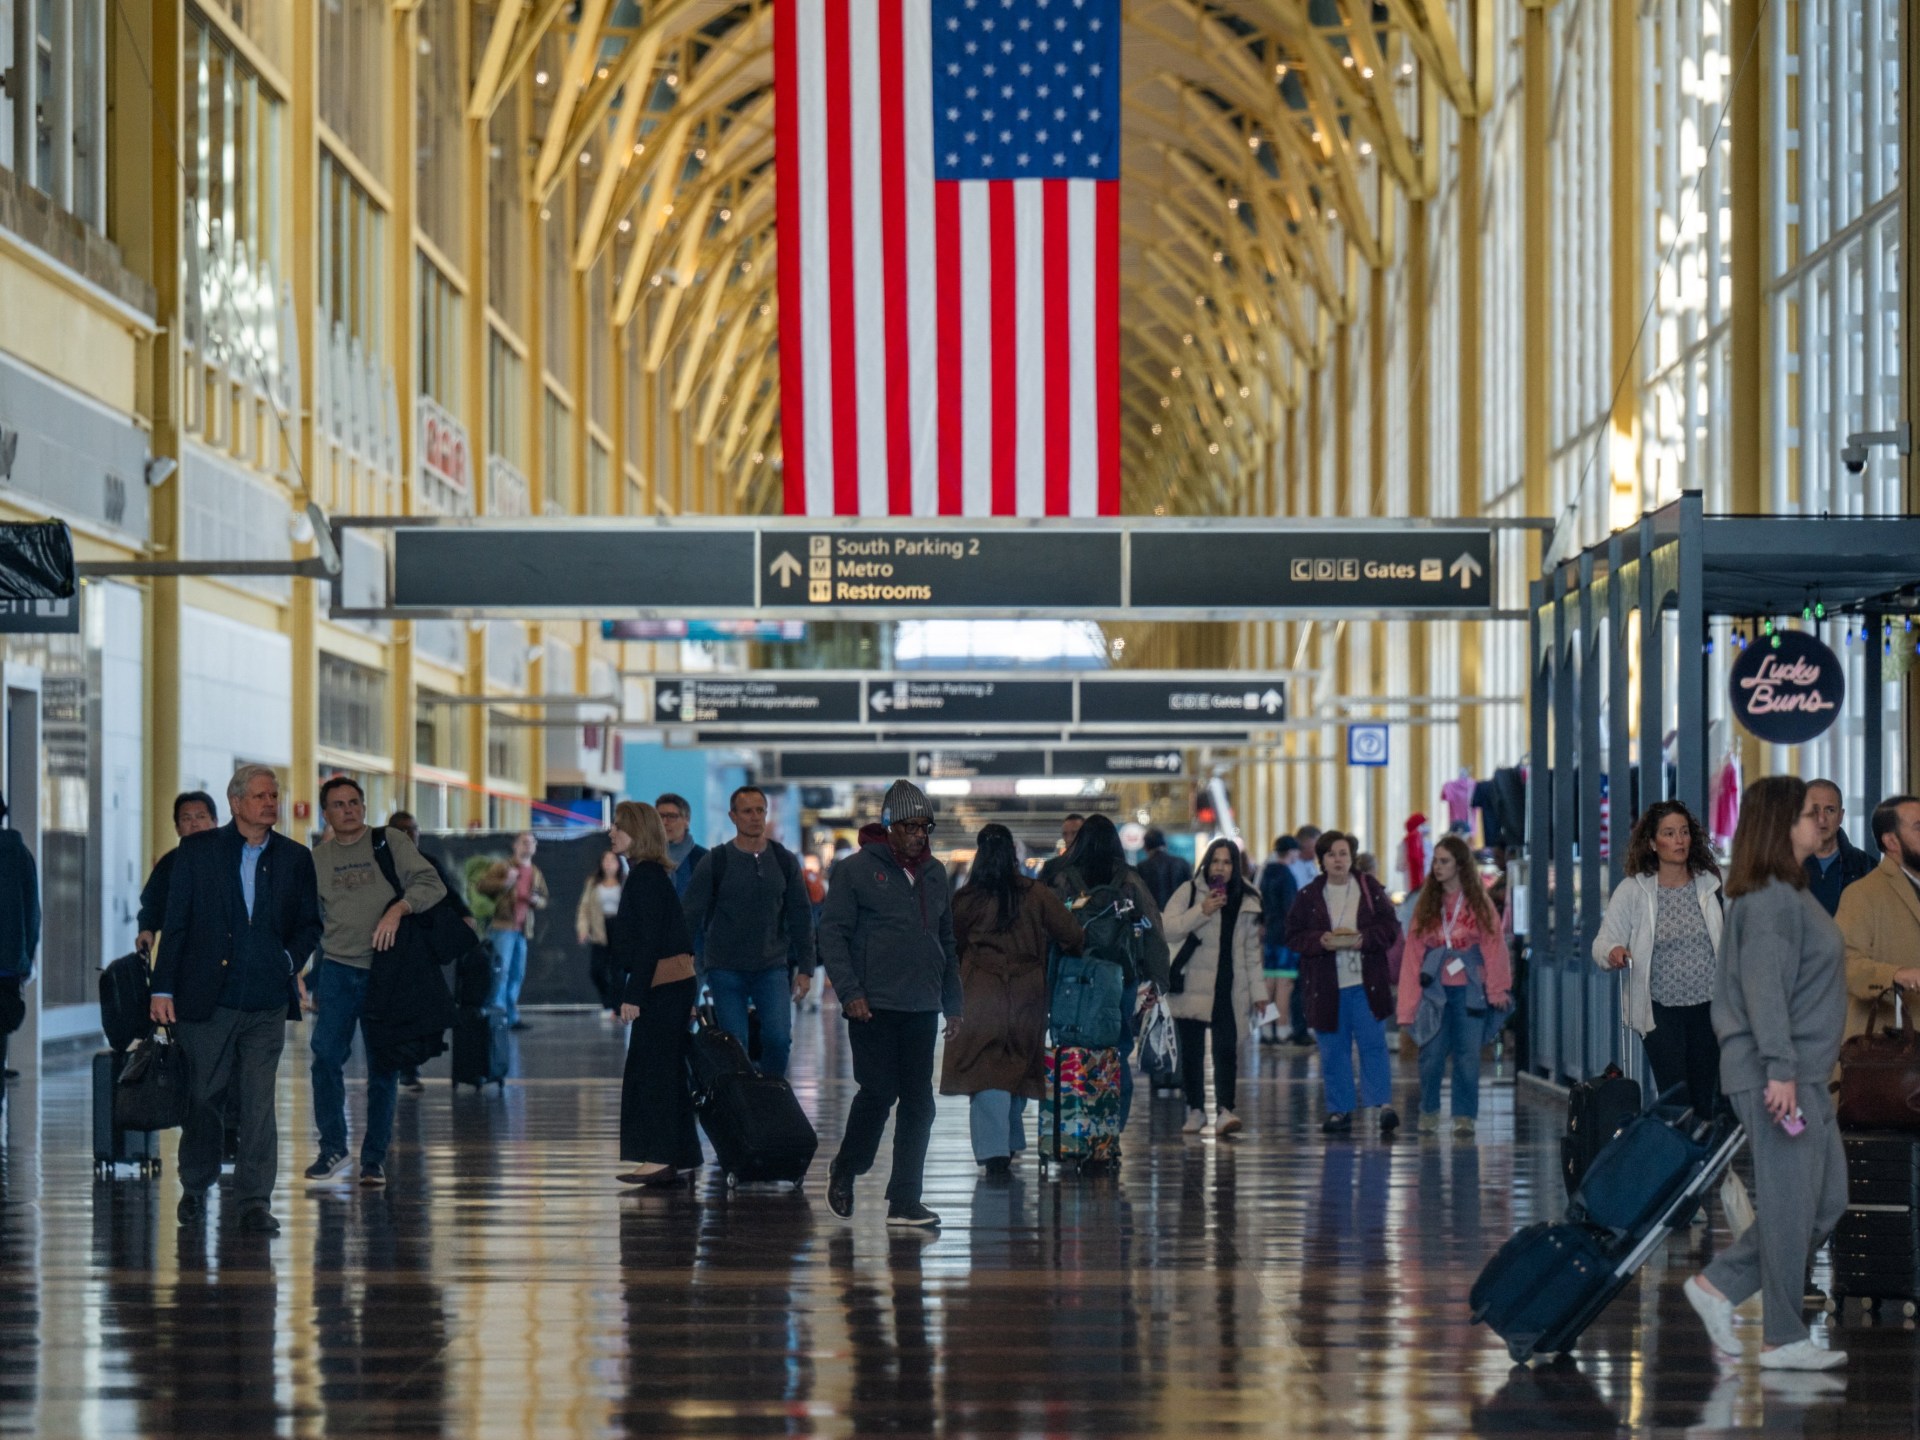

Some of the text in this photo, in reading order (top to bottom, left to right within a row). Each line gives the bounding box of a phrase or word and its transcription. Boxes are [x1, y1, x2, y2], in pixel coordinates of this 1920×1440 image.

[836, 538, 889, 556] South
[895, 538, 963, 559] Parking
[968, 538, 980, 556] 2
[836, 560, 893, 578] Metro
[1363, 560, 1416, 579] Gates
[836, 582, 931, 600] Restrooms
[1740, 654, 1821, 689] Lucky
[1747, 685, 1835, 714] Buns
